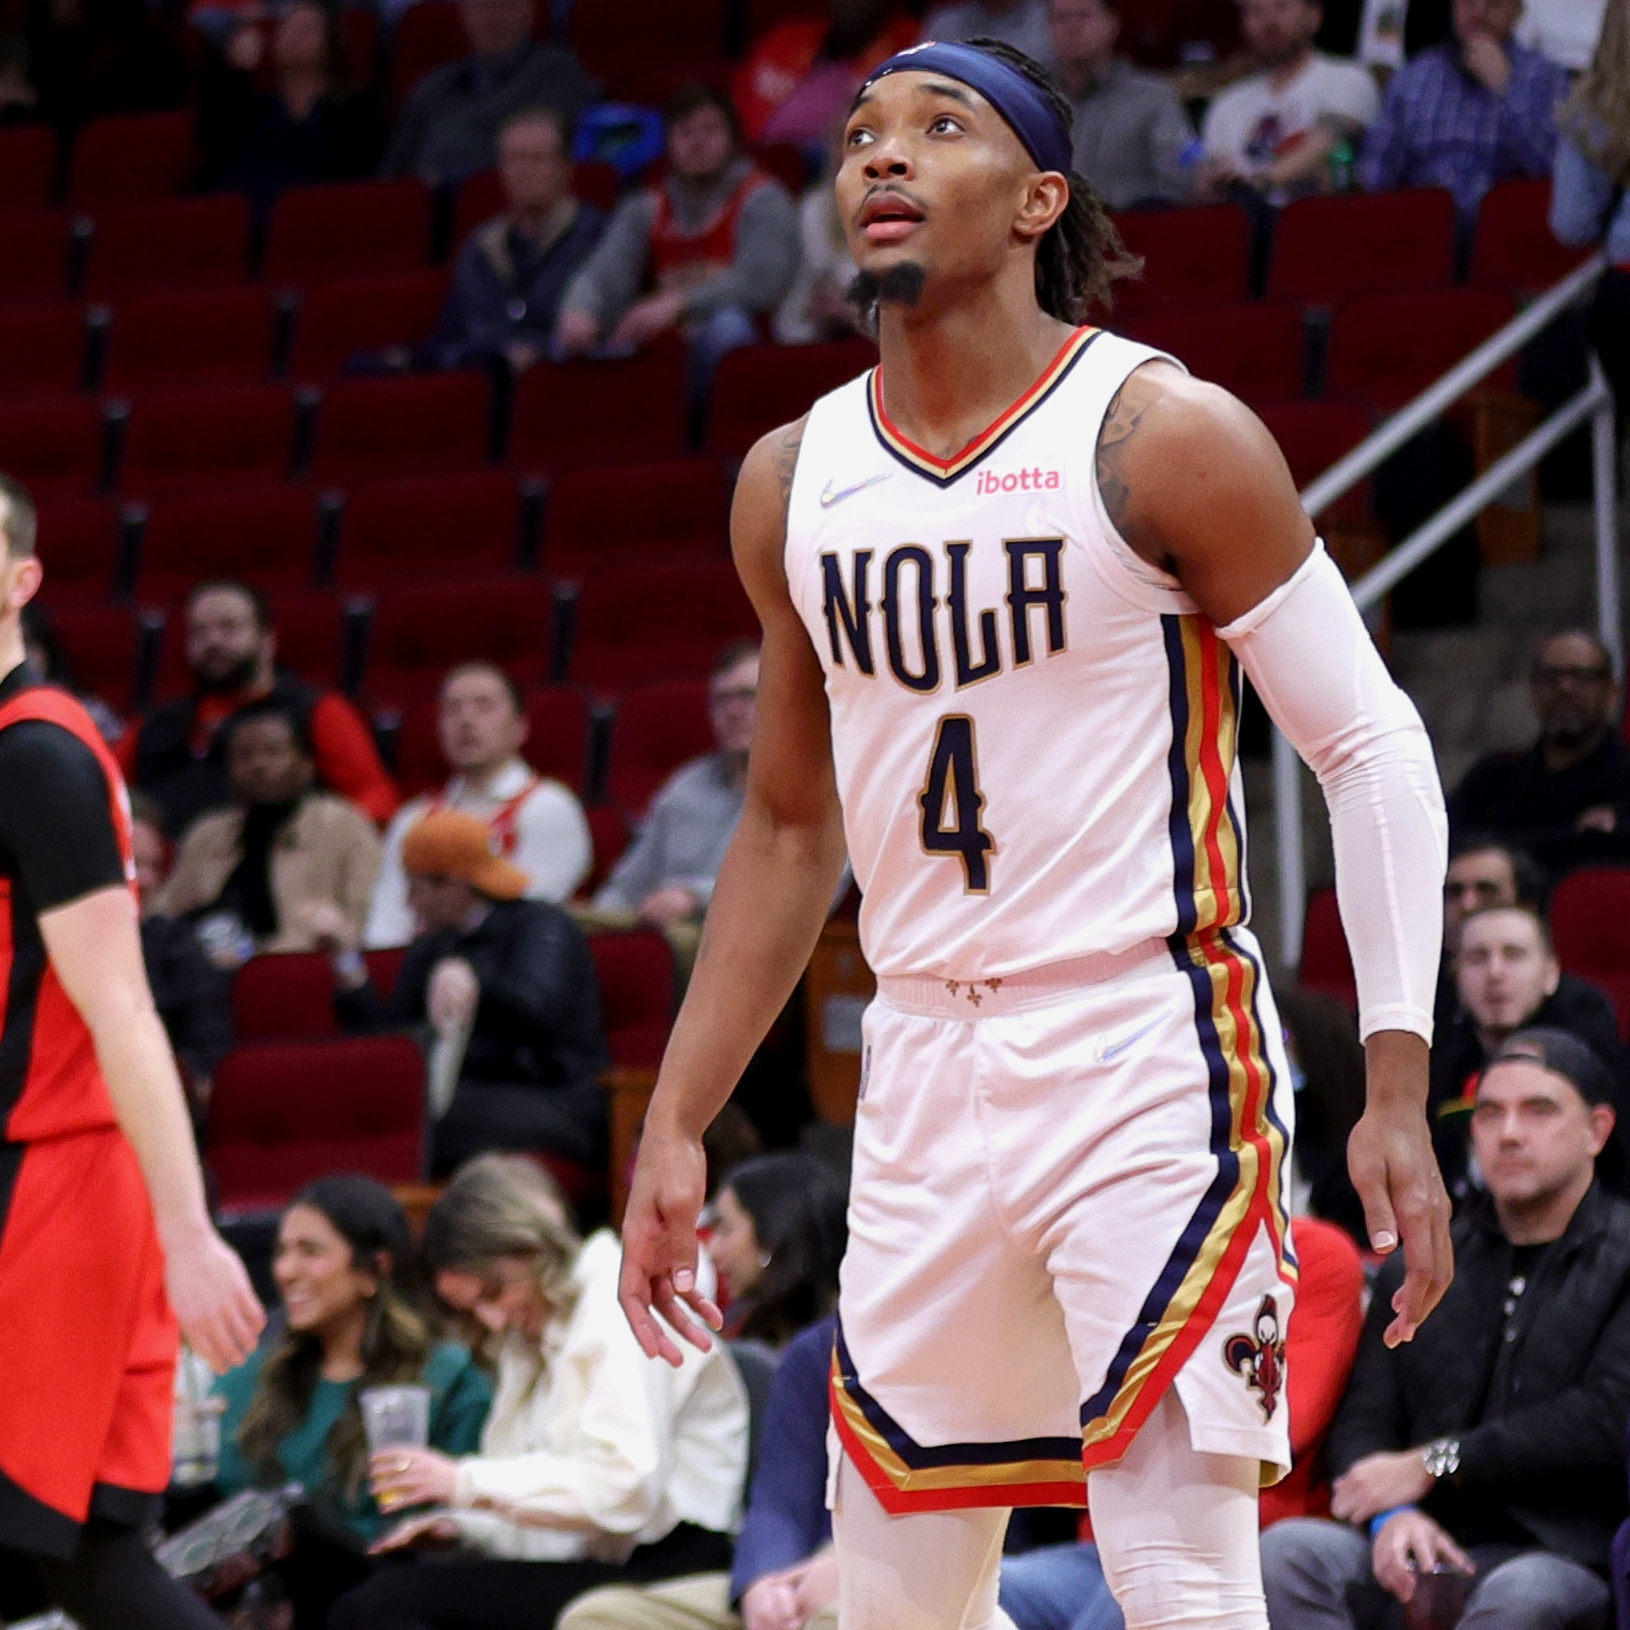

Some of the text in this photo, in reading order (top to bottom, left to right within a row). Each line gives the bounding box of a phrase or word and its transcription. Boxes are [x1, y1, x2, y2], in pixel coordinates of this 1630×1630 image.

[976, 467, 1059, 495] ibotta
[818, 537, 1068, 696] NOLA
[918, 713, 997, 896] 4
